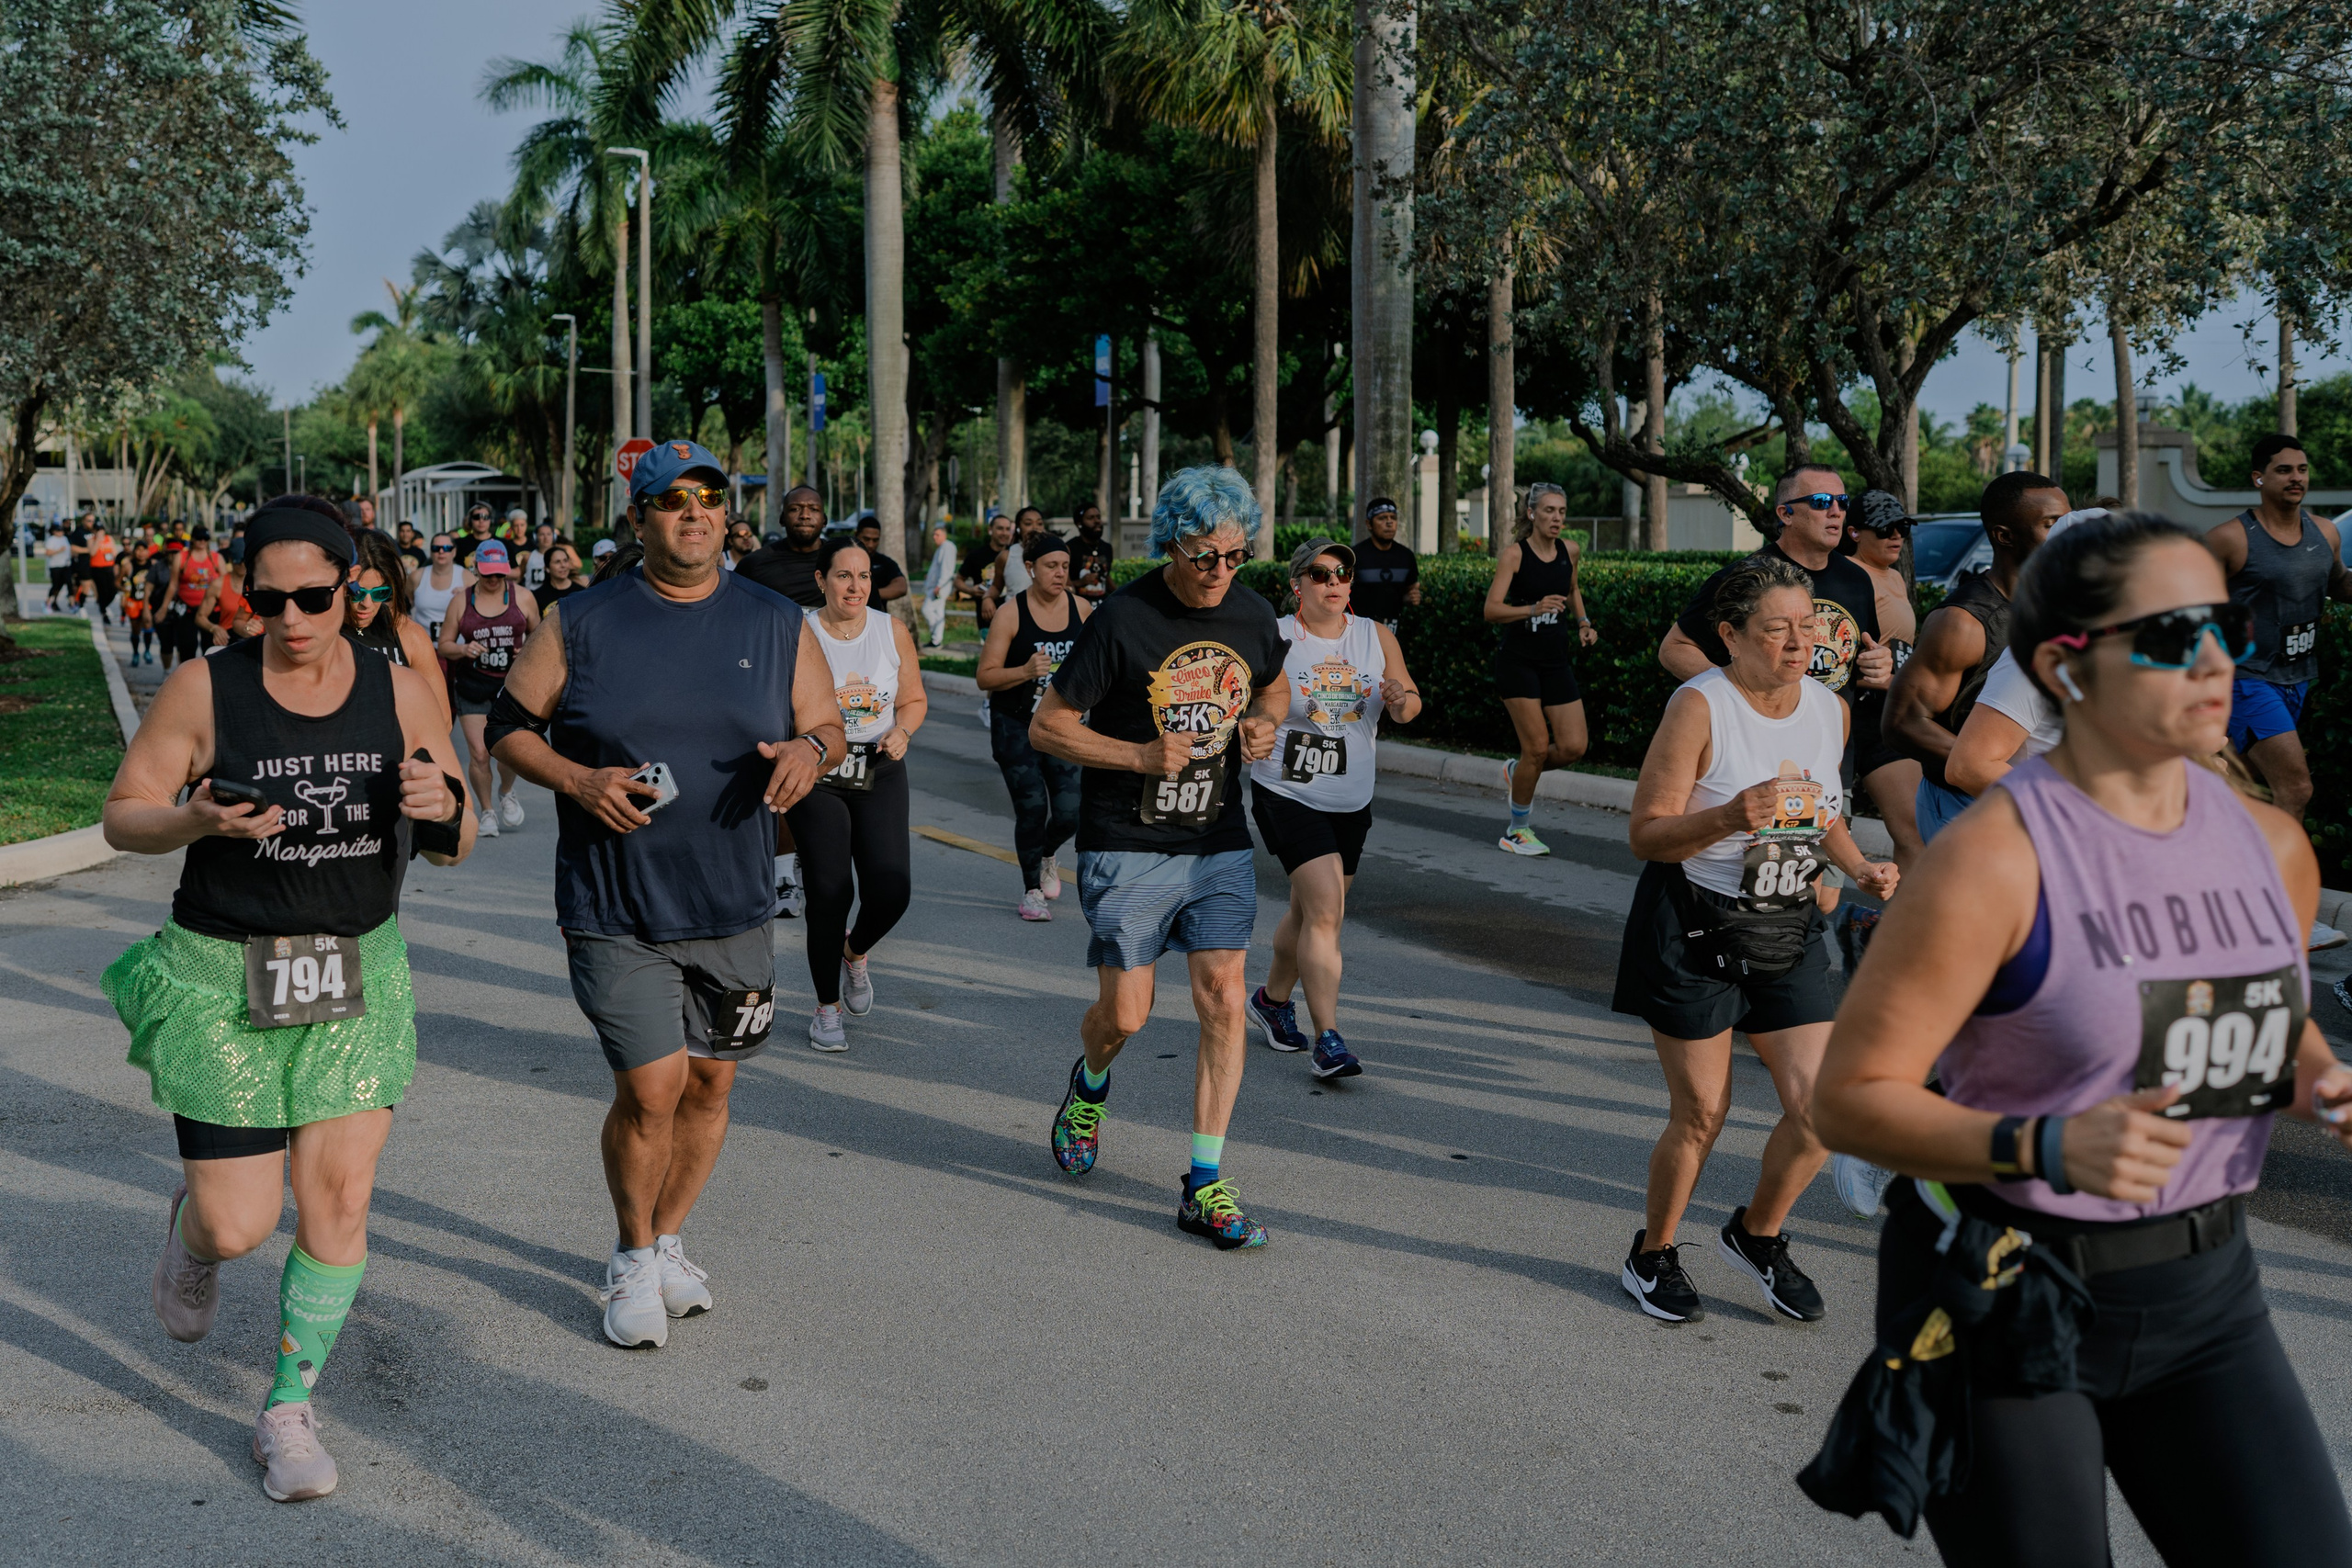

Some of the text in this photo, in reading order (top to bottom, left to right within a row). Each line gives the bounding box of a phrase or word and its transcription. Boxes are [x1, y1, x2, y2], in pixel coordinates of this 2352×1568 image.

[618, 452, 646, 471] ST
[473, 626, 514, 639] GOOD THINGS
[2286, 628, 2315, 656] 599
[490, 637, 497, 648] TO
[1034, 640, 1074, 656] TACO
[480, 652, 508, 667] 603
[1171, 666, 1212, 685] Cinco
[1191, 679, 1200, 688] de
[1173, 687, 1213, 702] Drinko
[848, 718, 859, 728] 5K
[1179, 704, 1209, 731] 5K
[1330, 714, 1340, 724] 5K
[852, 745, 865, 753] 5K
[1322, 739, 1338, 750] 5K
[252, 752, 382, 781] JUST HERE
[827, 753, 867, 779] 81
[1293, 744, 1340, 774] 790
[1194, 769, 1210, 780] 5K
[1156, 780, 1214, 813] 587
[278, 803, 370, 826] FOR THE
[254, 833, 382, 867] Margaritas
[1793, 845, 1813, 856] 5K
[1754, 858, 1817, 897] 882
[2079, 886, 2297, 969] NOBULL
[314, 936, 339, 952] 5K
[266, 953, 347, 1006] 794
[2244, 978, 2283, 1009] 5K
[2161, 1007, 2291, 1096] 994
[288, 1283, 357, 1307] Salty
